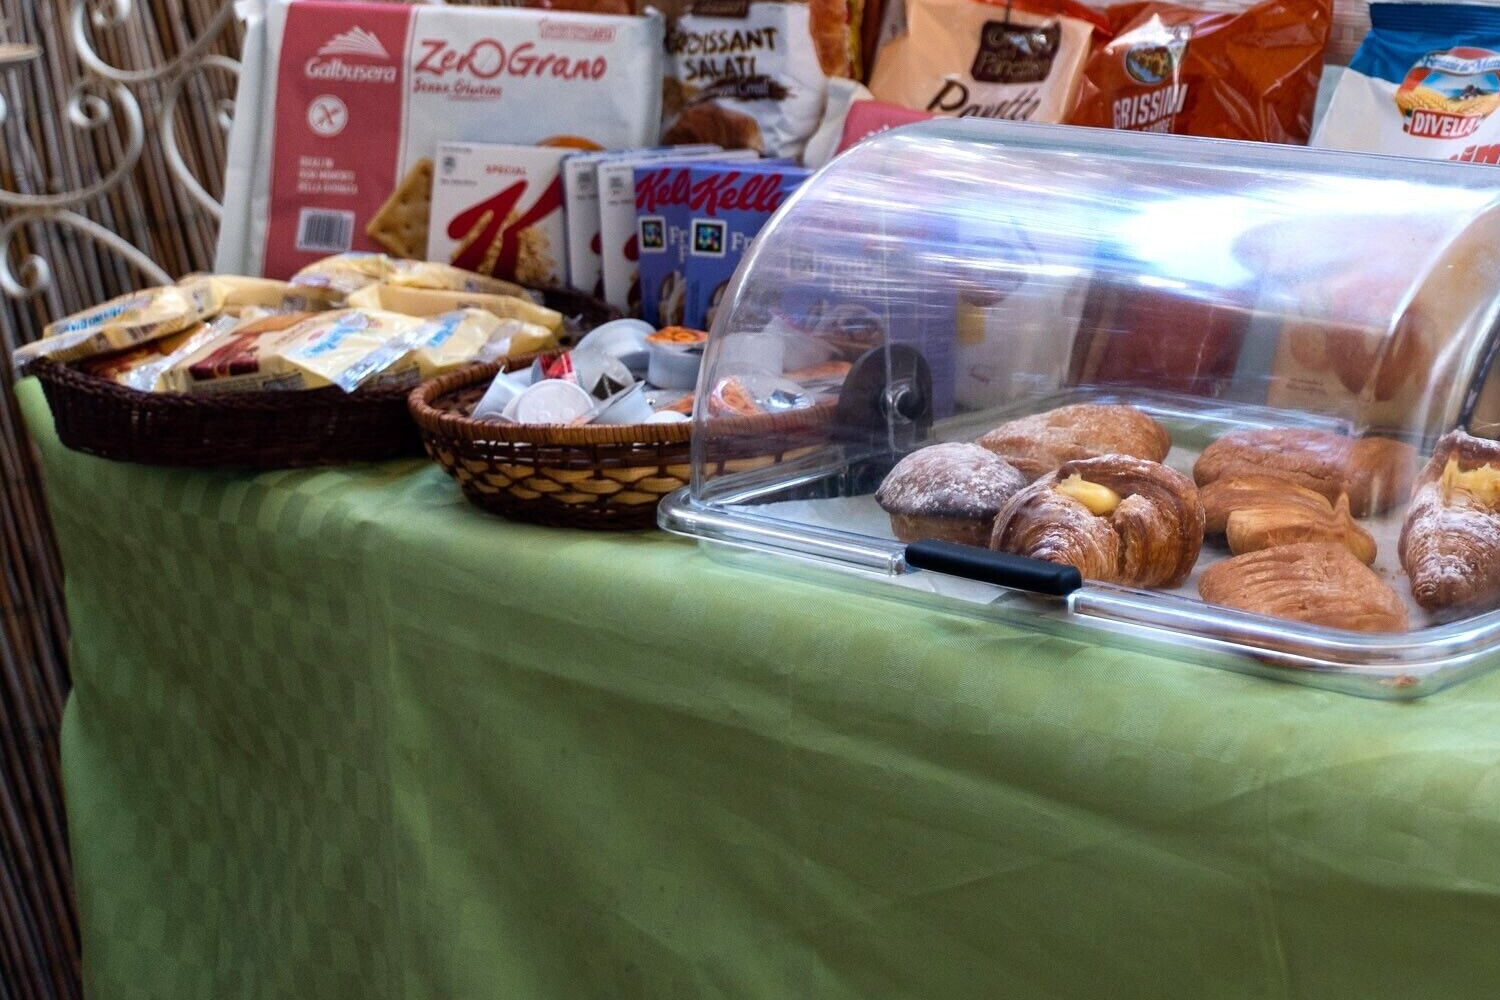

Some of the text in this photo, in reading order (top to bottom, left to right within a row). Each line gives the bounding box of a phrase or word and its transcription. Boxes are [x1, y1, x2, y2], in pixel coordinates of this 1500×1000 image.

[666, 26, 778, 56] ROISSANT
[304, 57, 398, 83] Galbusera
[684, 56, 757, 81] SALATI
[1113, 83, 1188, 130] GRISSINI
[1413, 112, 1477, 137] DIVELLA
[485, 164, 526, 176] SPECIAL
